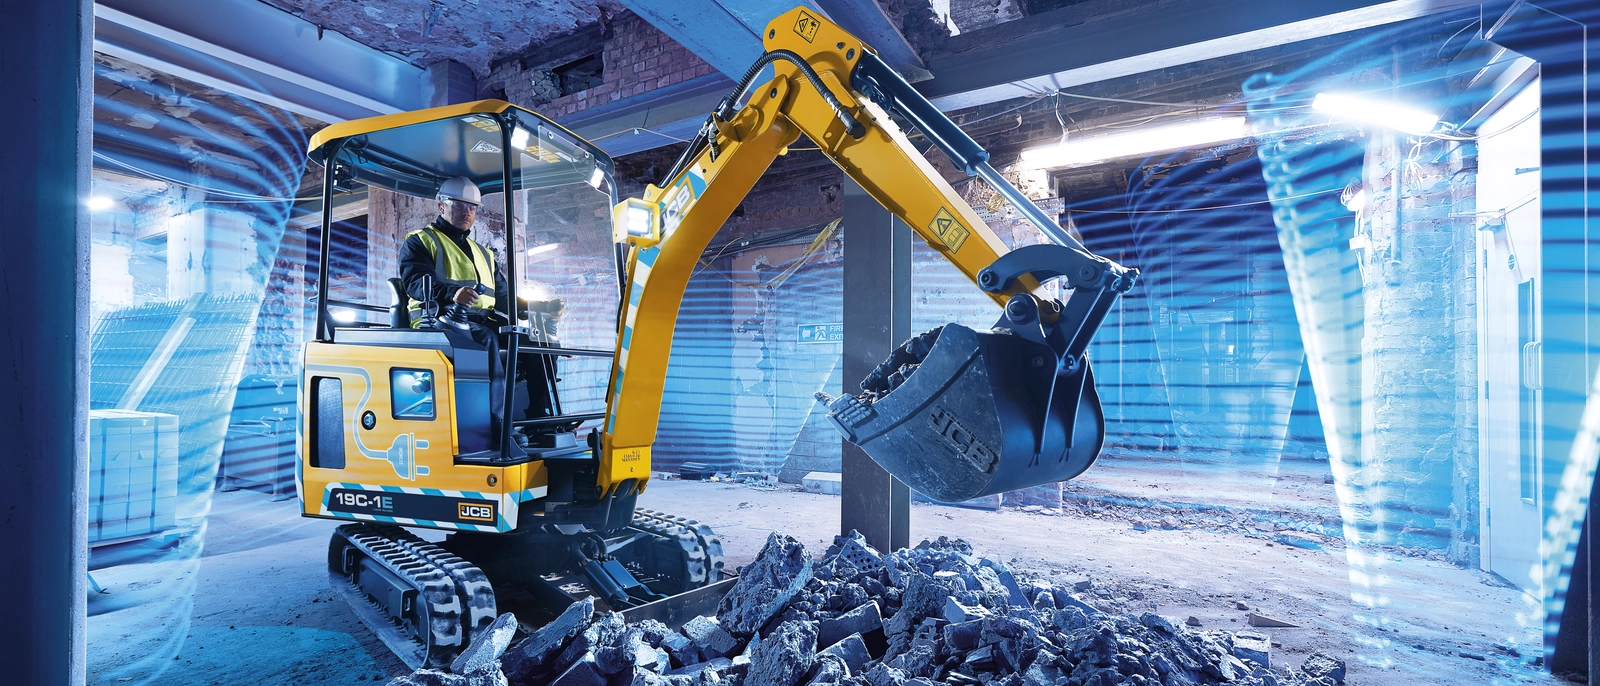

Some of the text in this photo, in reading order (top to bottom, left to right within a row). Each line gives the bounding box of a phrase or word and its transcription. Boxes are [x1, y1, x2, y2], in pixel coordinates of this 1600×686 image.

[927, 404, 998, 474] JCB
[335, 492, 393, 509] 19C-1E
[461, 505, 491, 518] JCB
